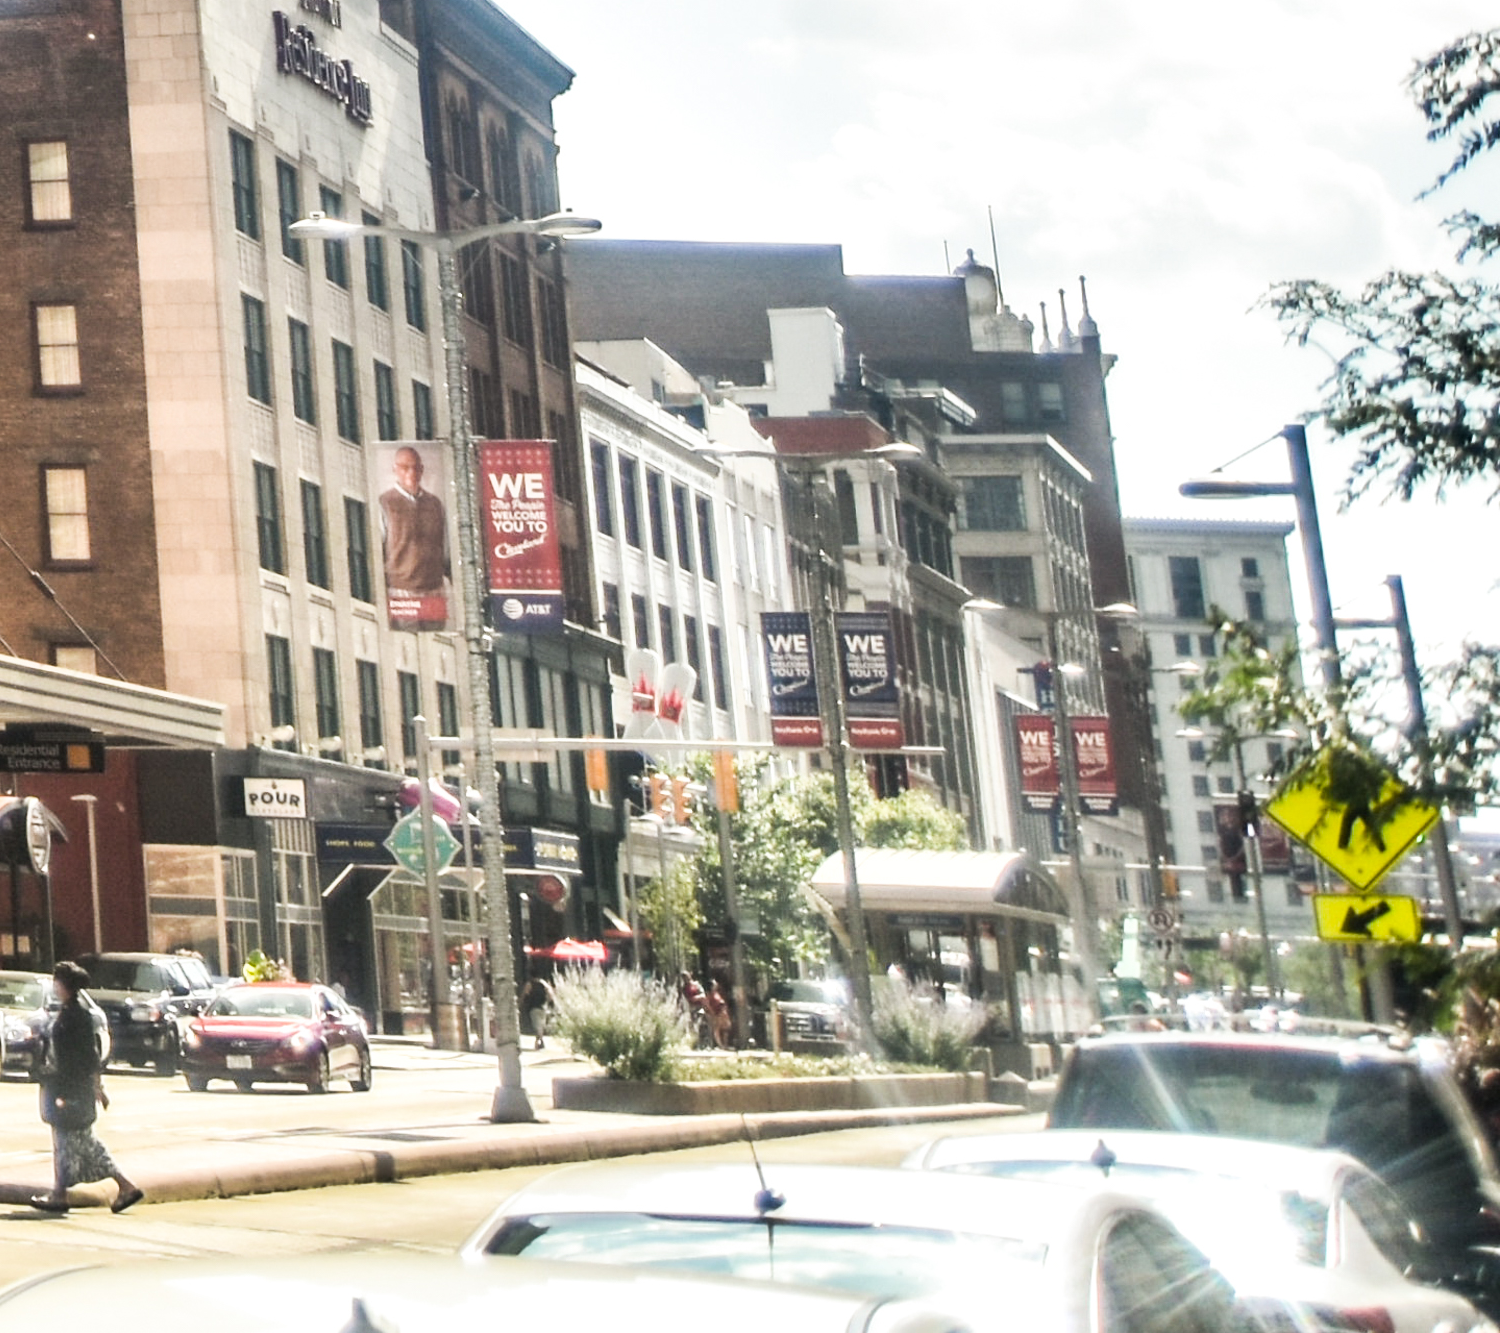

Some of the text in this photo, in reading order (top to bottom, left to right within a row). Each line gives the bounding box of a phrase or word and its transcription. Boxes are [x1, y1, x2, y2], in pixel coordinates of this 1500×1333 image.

[488, 472, 546, 499] WE
[491, 510, 547, 522] WELCOME
[492, 520, 548, 534] YOU TO
[525, 603, 552, 616] AT&T
[767, 633, 809, 654] WE
[843, 634, 886, 654] WE
[771, 668, 810, 678] YOU TO
[848, 668, 888, 678] YOU TO
[1019, 730, 1050, 746] WE
[1075, 731, 1106, 747] WE
[7, 757, 61, 769] Entrance
[248, 791, 301, 808] POUR
